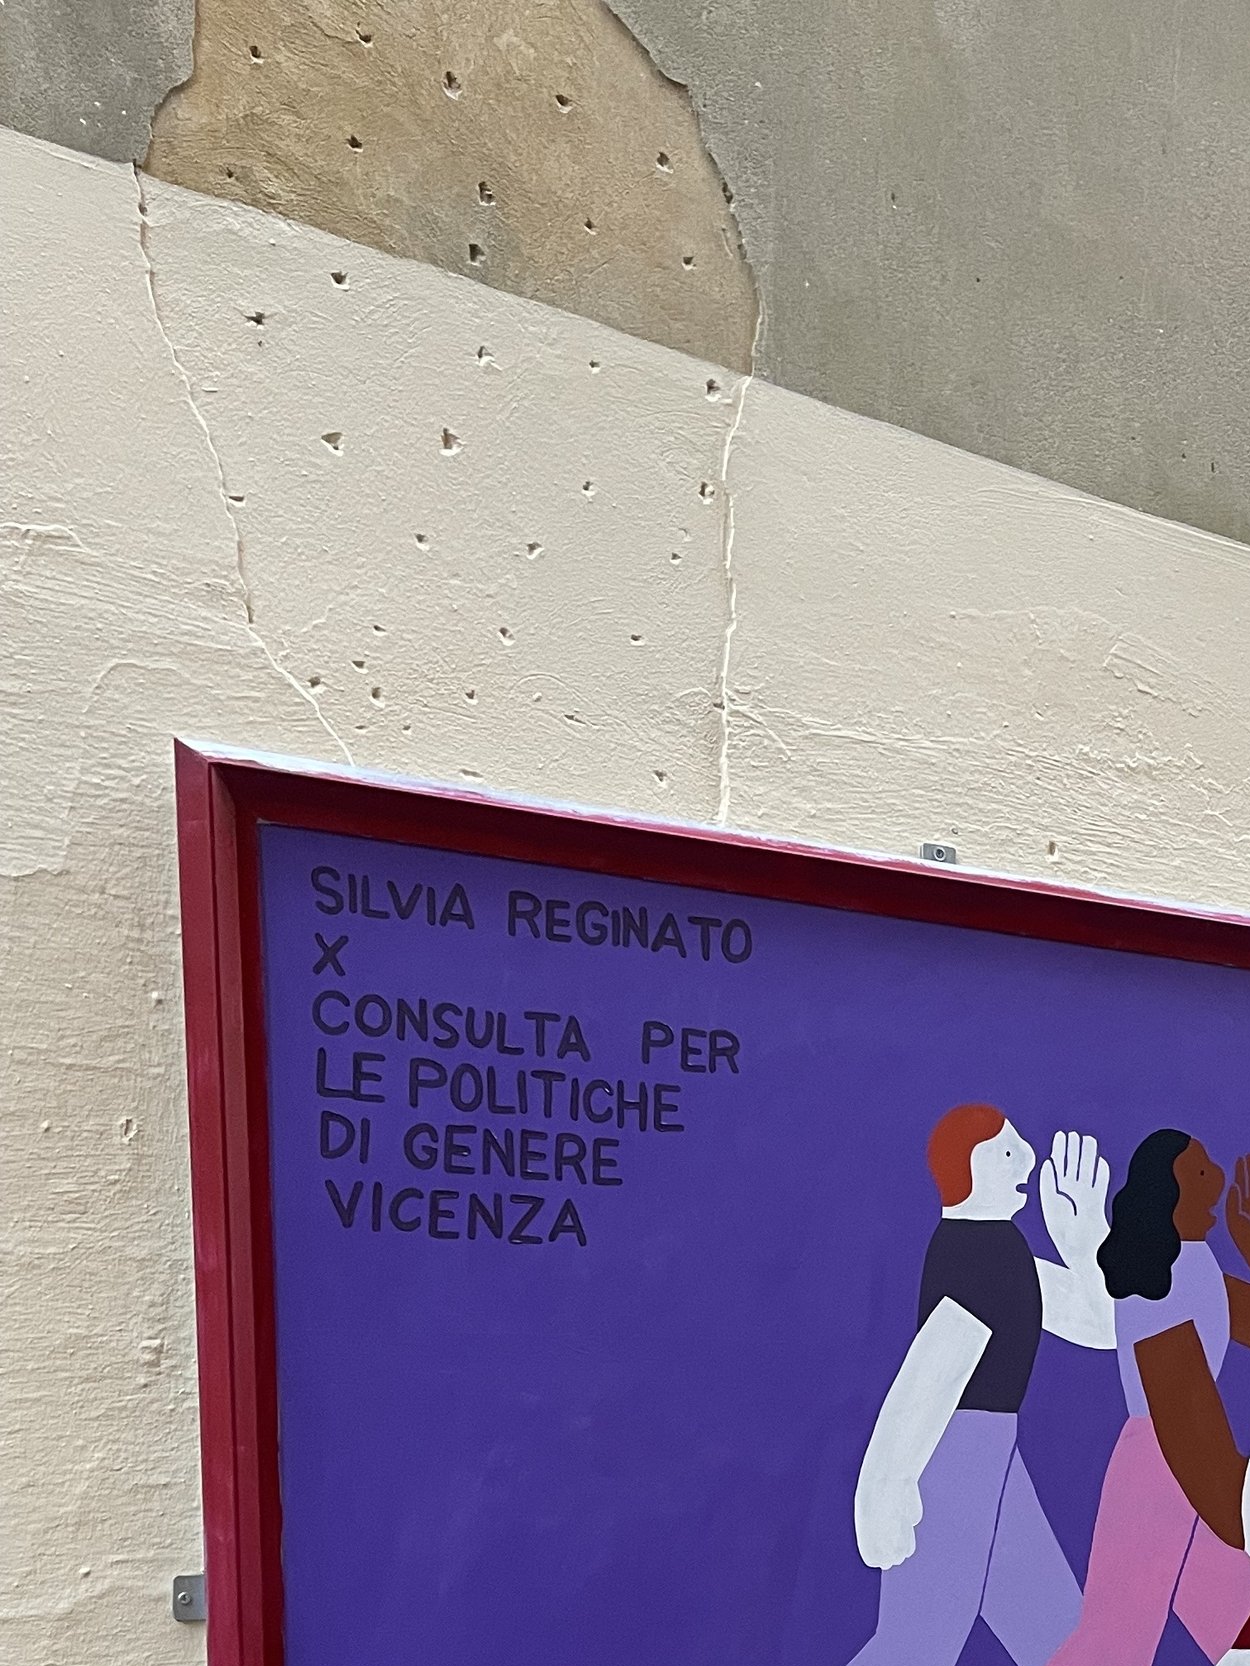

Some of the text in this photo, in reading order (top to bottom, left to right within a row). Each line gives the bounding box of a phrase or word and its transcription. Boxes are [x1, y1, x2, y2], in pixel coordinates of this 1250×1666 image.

[311, 866, 752, 963] SILVIA REGINATO
[312, 933, 348, 976] X
[312, 990, 740, 1073] CONSULTA PER
[316, 1047, 684, 1132] LE POLITICHE
[320, 1110, 623, 1185] DI GENERE
[325, 1179, 586, 1246] VICENZA
